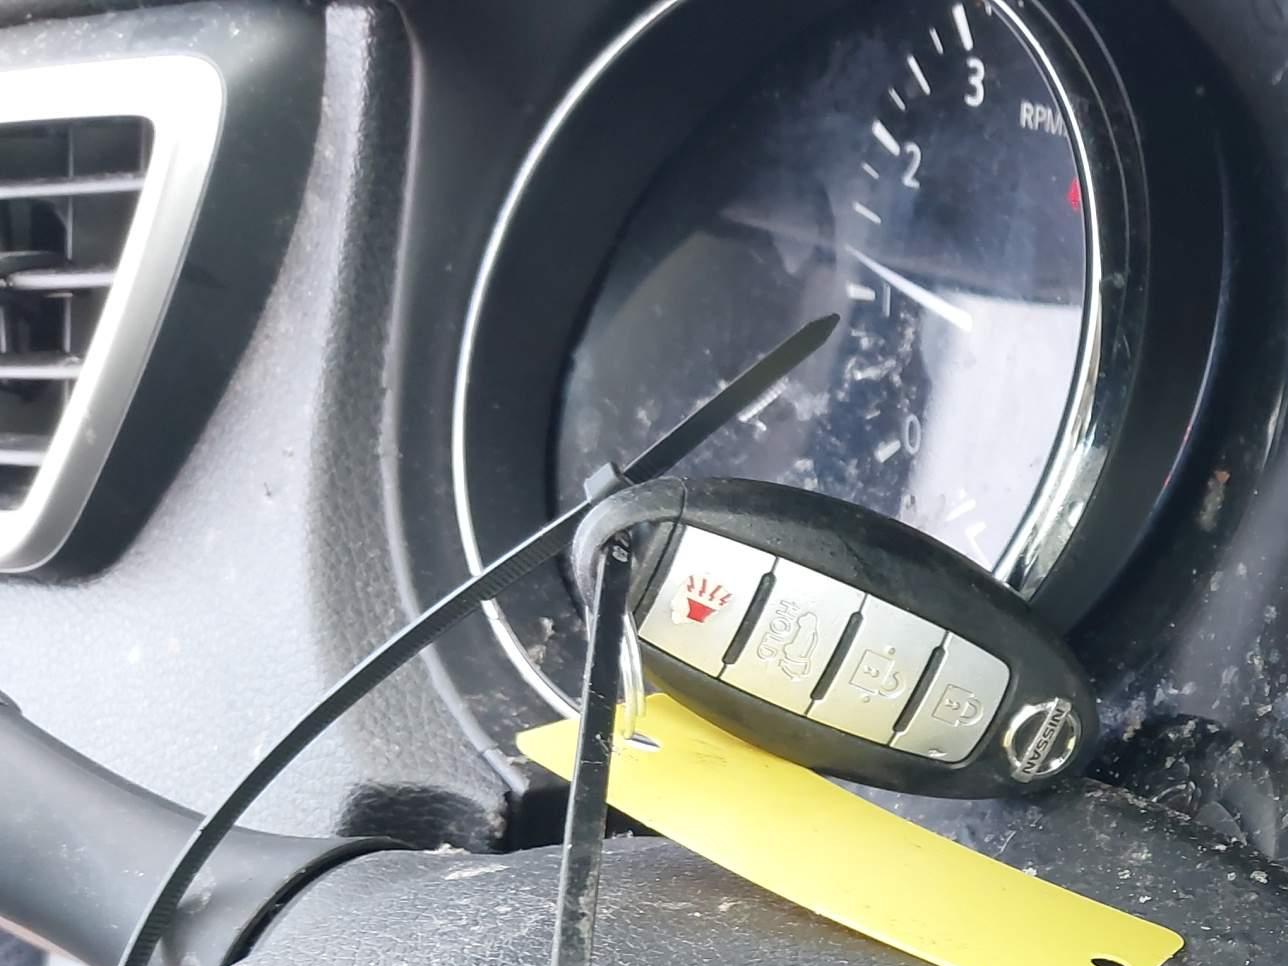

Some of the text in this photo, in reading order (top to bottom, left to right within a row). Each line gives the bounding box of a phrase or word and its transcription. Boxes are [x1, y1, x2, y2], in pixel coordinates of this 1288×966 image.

[964, 57, 986, 106] 3
[898, 142, 922, 188] 2
[905, 414, 921, 454] 0
[1022, 708, 1065, 775] NISSAN
